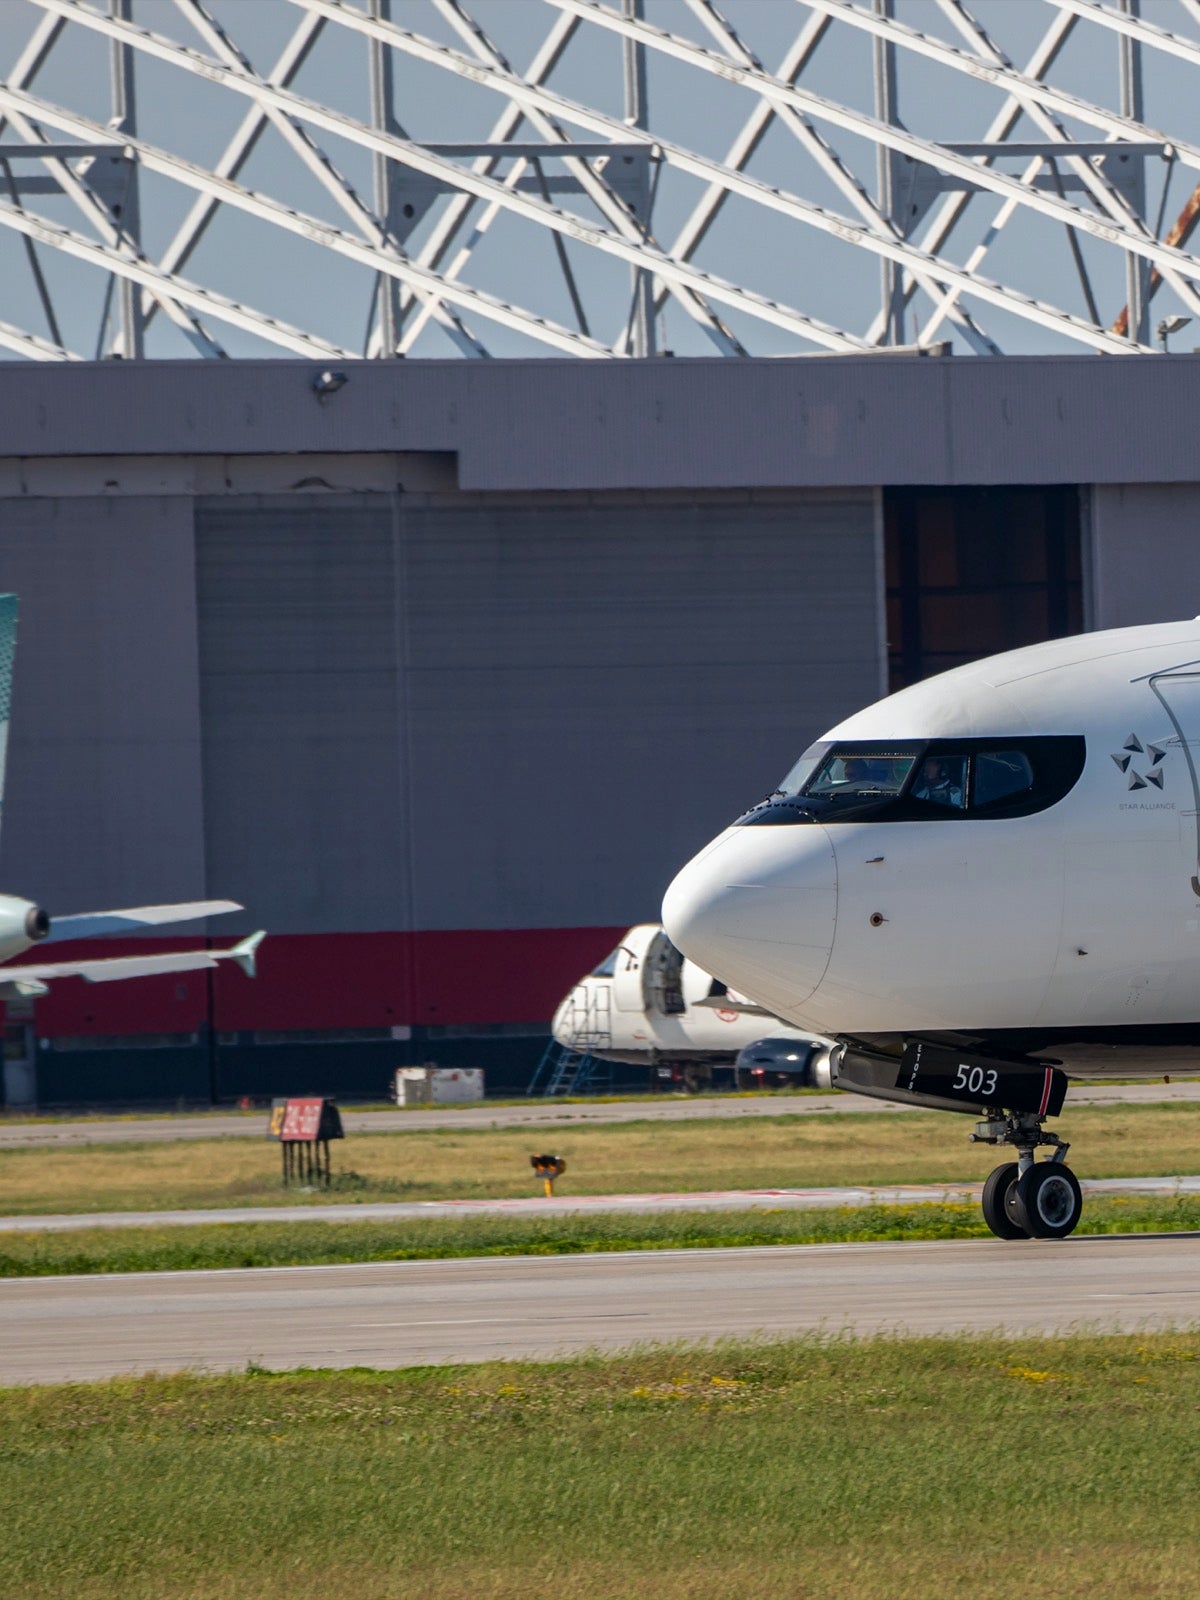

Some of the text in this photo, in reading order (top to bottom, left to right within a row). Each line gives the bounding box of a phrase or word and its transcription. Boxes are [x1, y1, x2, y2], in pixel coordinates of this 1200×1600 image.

[1119, 803, 1138, 811] STAR
[908, 1044, 922, 1090] ETOPS
[952, 1063, 998, 1095] 503
